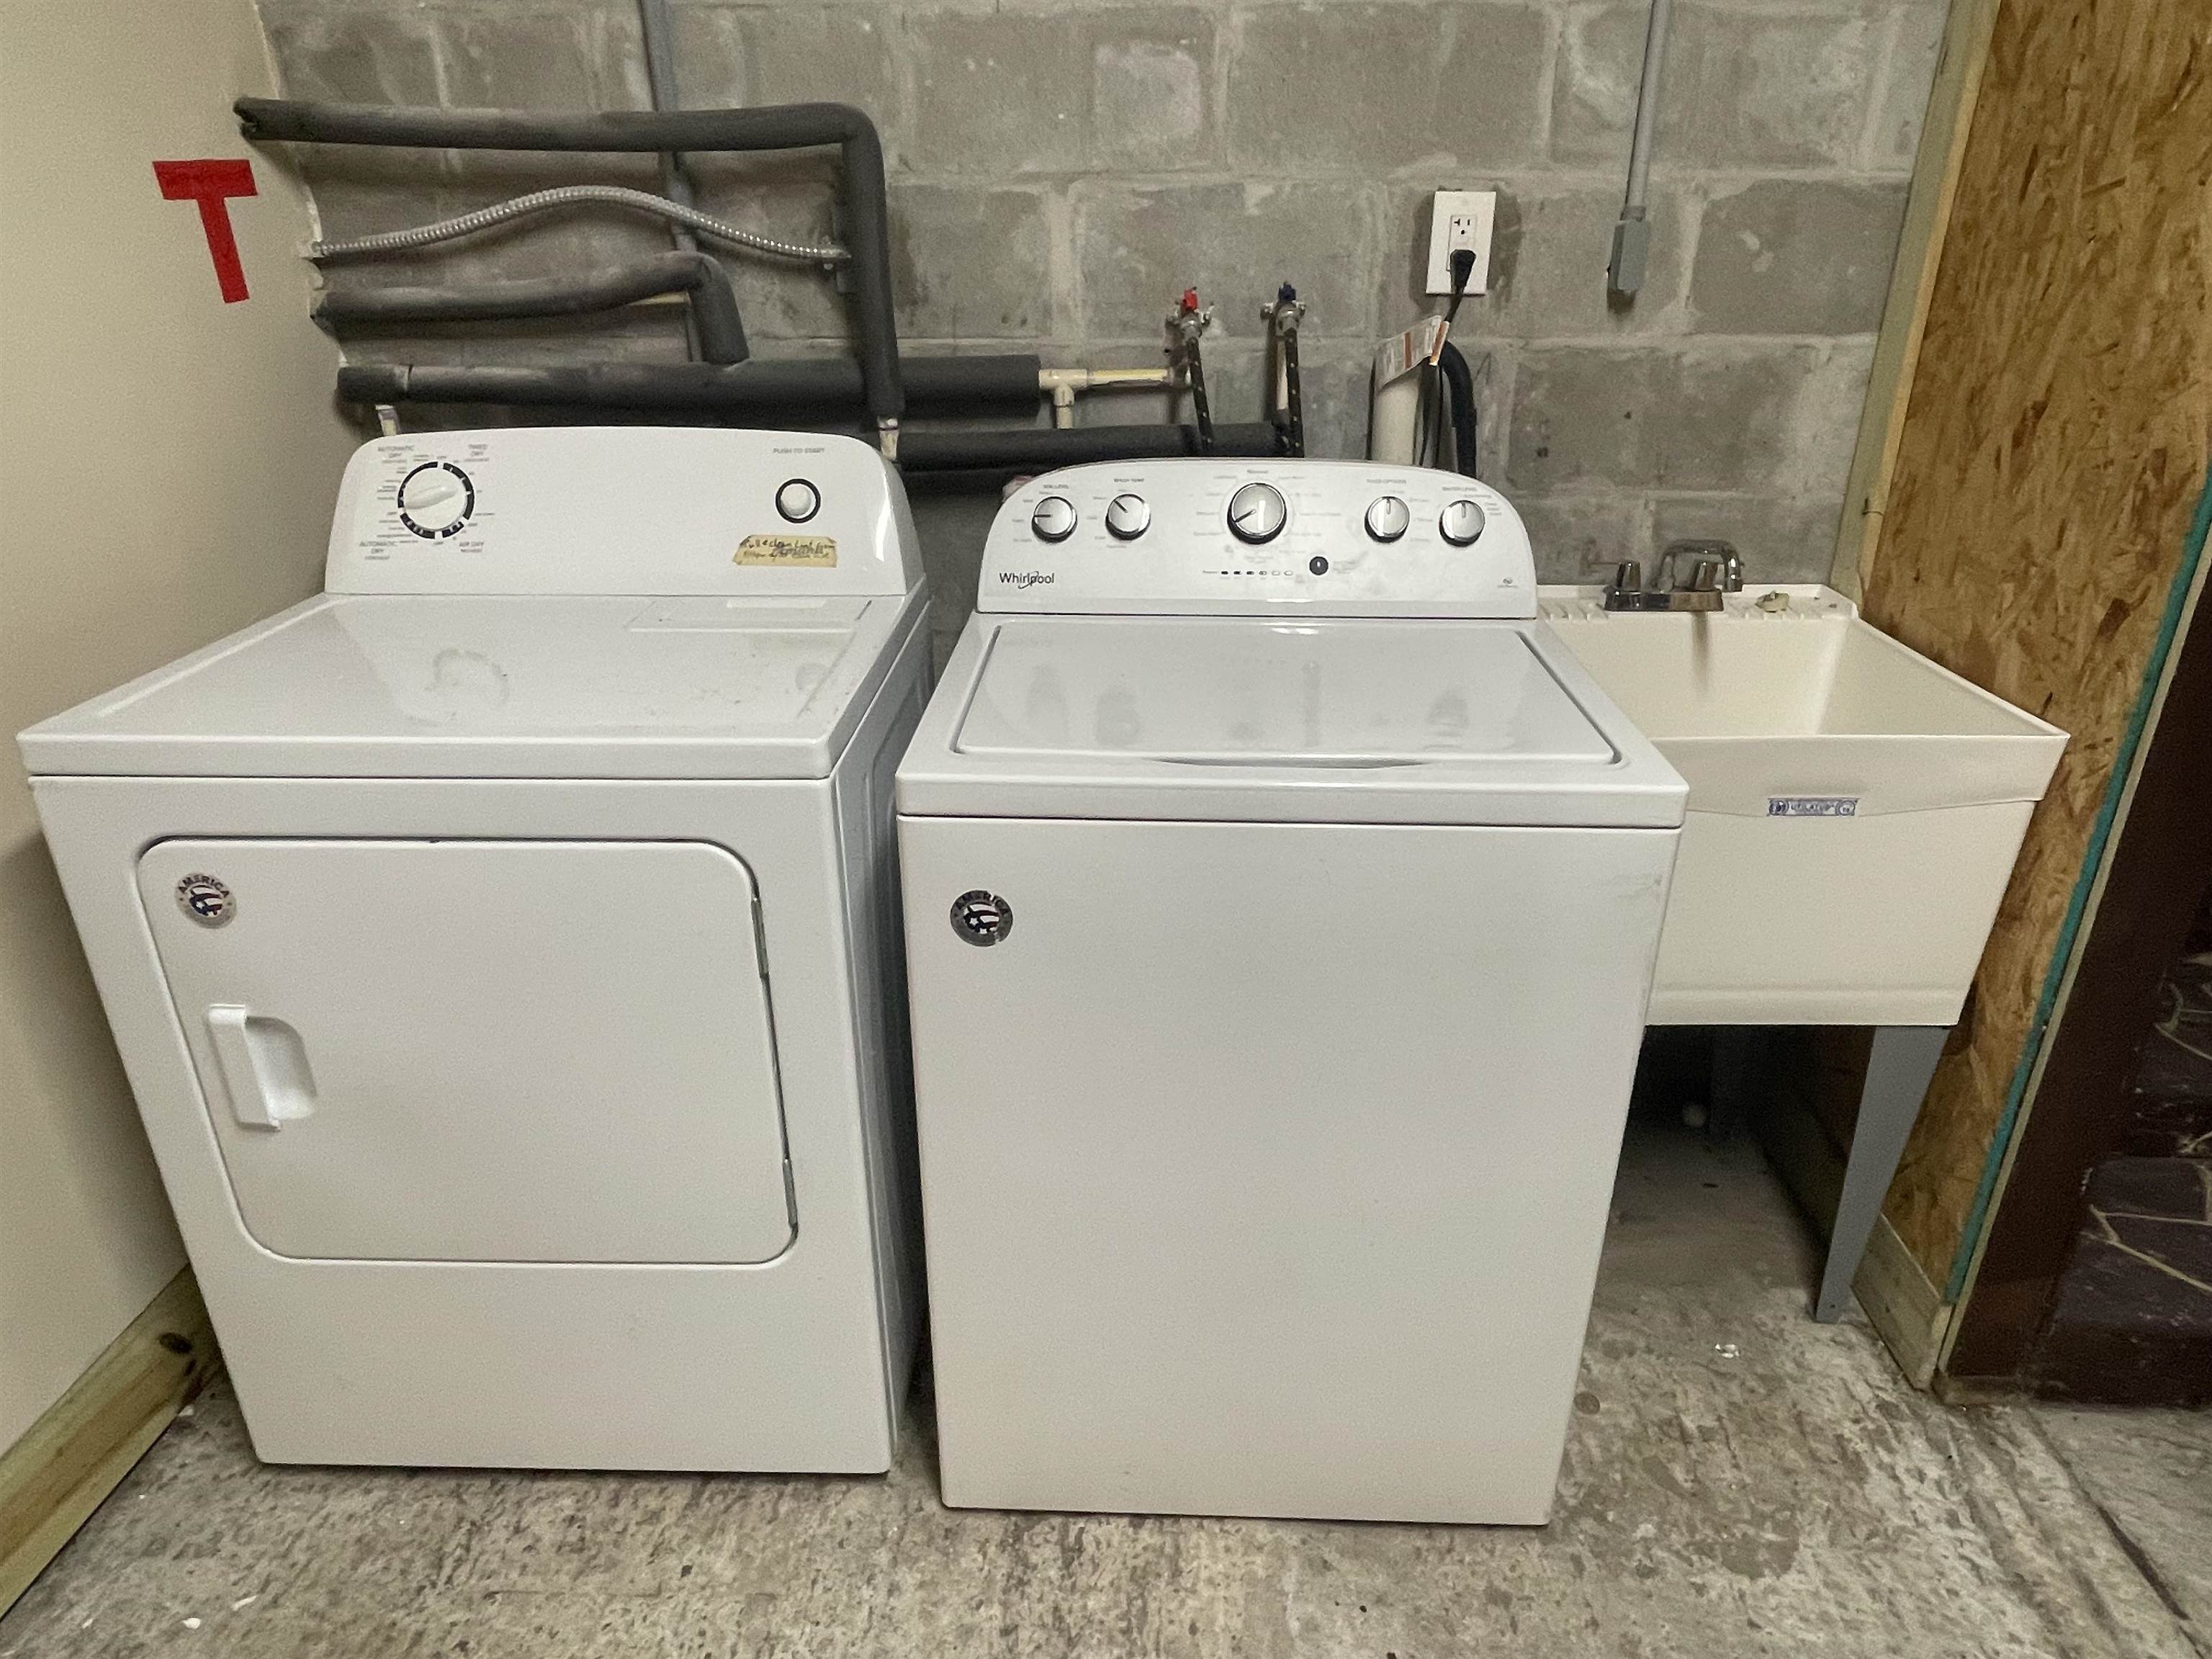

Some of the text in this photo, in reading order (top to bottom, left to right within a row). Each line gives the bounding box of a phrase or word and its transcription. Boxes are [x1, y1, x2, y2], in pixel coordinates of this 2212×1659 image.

[152, 158, 258, 303] T
[999, 570, 1055, 590] Whirlpool
[178, 874, 230, 898] AMERICA
